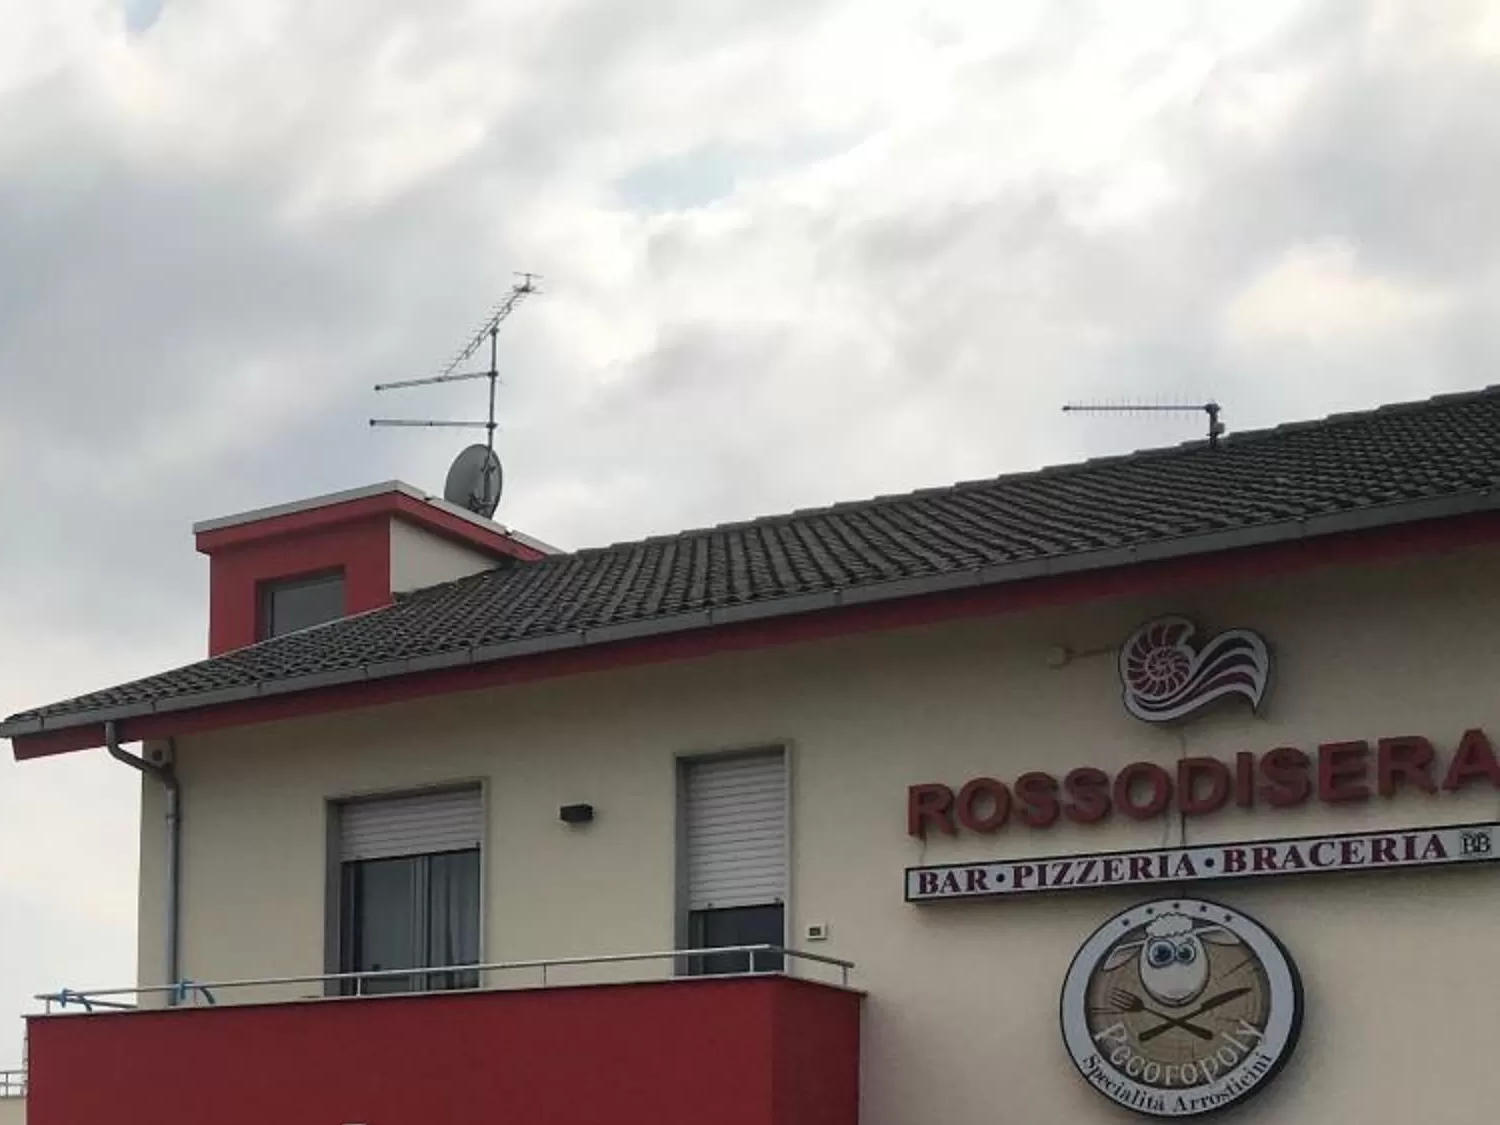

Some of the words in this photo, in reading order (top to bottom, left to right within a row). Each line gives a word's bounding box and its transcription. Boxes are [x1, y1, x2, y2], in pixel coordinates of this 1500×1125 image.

[907, 728, 1500, 838] ROSSODISERA
[918, 868, 991, 895] BAR
[1011, 853, 1198, 889] PIZZERIA
[1221, 833, 1448, 874] BRACERIA
[1172, 1052, 1274, 1112] Arrosticini
